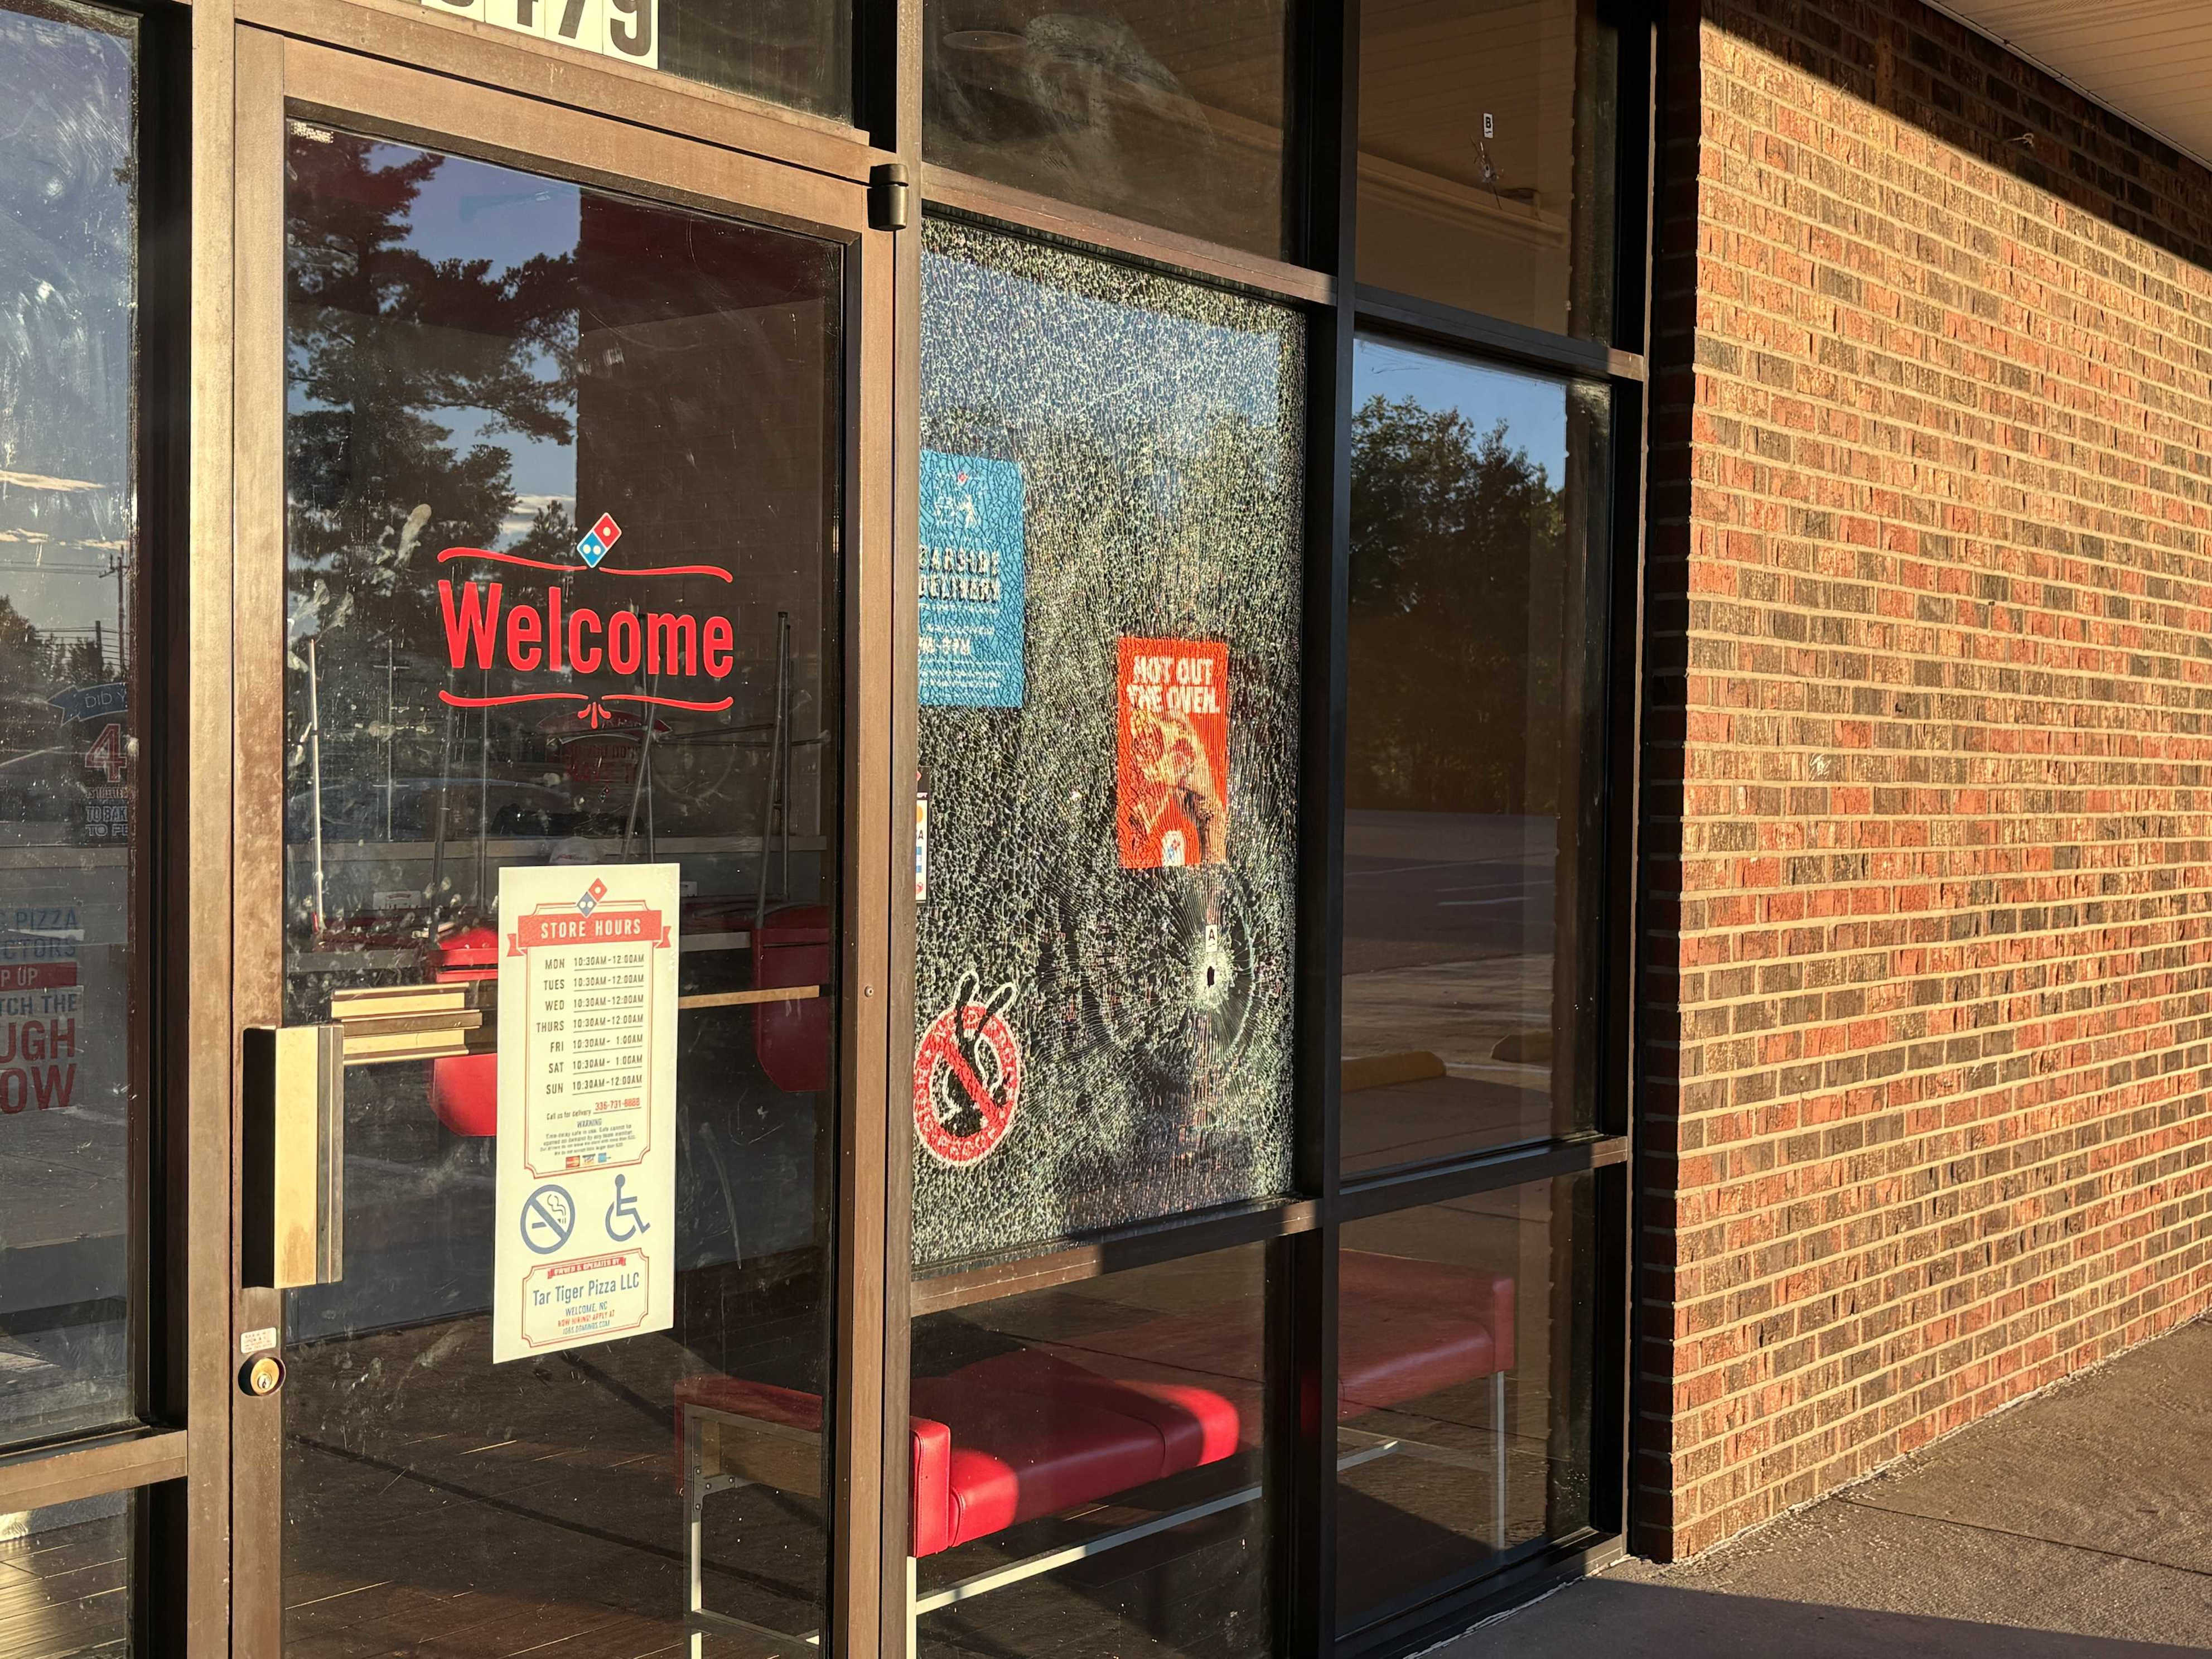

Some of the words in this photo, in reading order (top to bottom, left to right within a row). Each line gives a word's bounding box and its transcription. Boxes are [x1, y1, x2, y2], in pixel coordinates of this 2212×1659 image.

[1486, 117, 1491, 128] B
[438, 580, 733, 678] Welcome
[1176, 658, 1213, 685] OUT
[85, 691, 112, 708] DID
[85, 724, 127, 783] 4
[85, 806, 102, 822] TO
[85, 824, 108, 836] TO
[17, 906, 80, 930] PIZZA
[540, 921, 586, 939] STORE
[595, 919, 641, 936] HOURS
[1209, 928, 1215, 941] A
[545, 958, 564, 970] MON
[18, 966, 38, 987] UP
[544, 980, 564, 990] TUES
[41, 993, 78, 1013] THE
[545, 1000, 564, 1011] WED
[537, 1021, 564, 1033] THURS
[550, 1041, 564, 1053] FRI
[549, 1062, 564, 1073] SAT
[546, 1083, 563, 1094] SUN
[577, 1118, 602, 1128] WARNING
[533, 1290, 550, 1306] Tar
[556, 1285, 584, 1304] Tiger
[588, 1279, 616, 1296] Pizza
[621, 1272, 639, 1290] LLC
[599, 1301, 607, 1310] NC
[592, 1312, 607, 1320] APPLY
